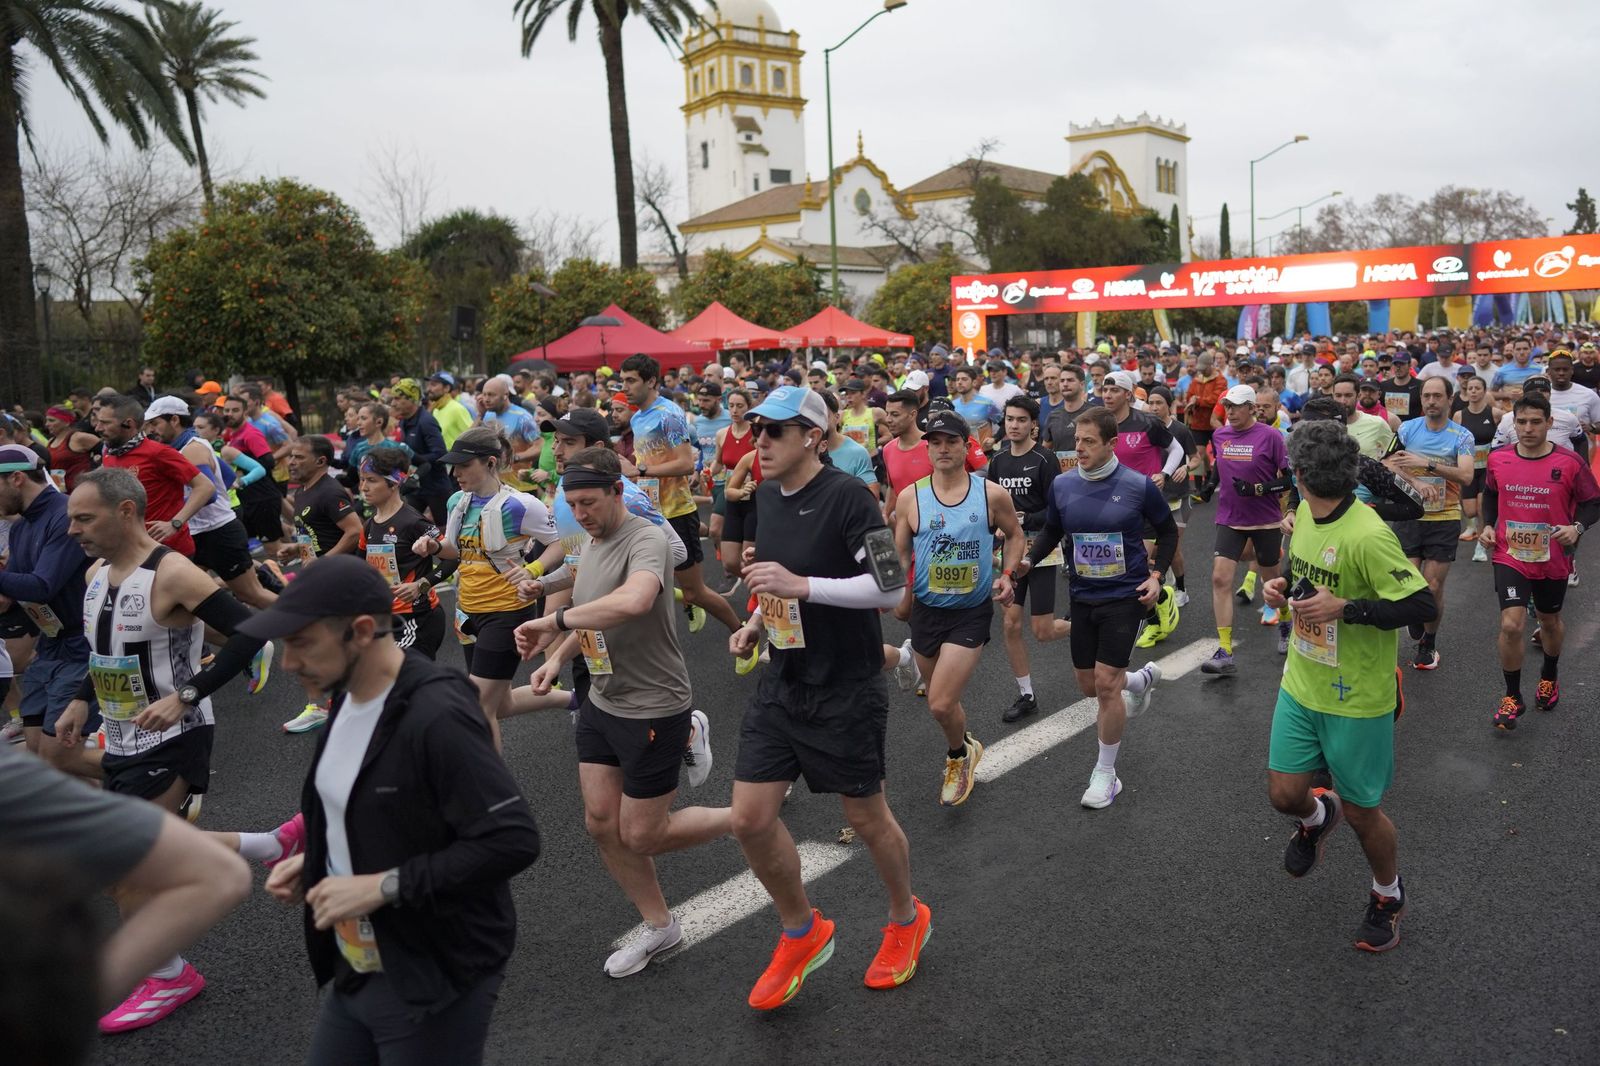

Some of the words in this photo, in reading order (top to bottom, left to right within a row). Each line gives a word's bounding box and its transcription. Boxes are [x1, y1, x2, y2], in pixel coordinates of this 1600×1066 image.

[1362, 262, 1418, 283] HOKA
[999, 476, 1033, 488] torre
[1505, 483, 1550, 495] telepizza
[1511, 531, 1539, 545] 4567
[956, 549, 980, 561] BIKES
[1081, 544, 1112, 559] 2726
[935, 566, 969, 581] 9897
[1309, 563, 1339, 588] BETIS
[93, 670, 131, 693] 11672
